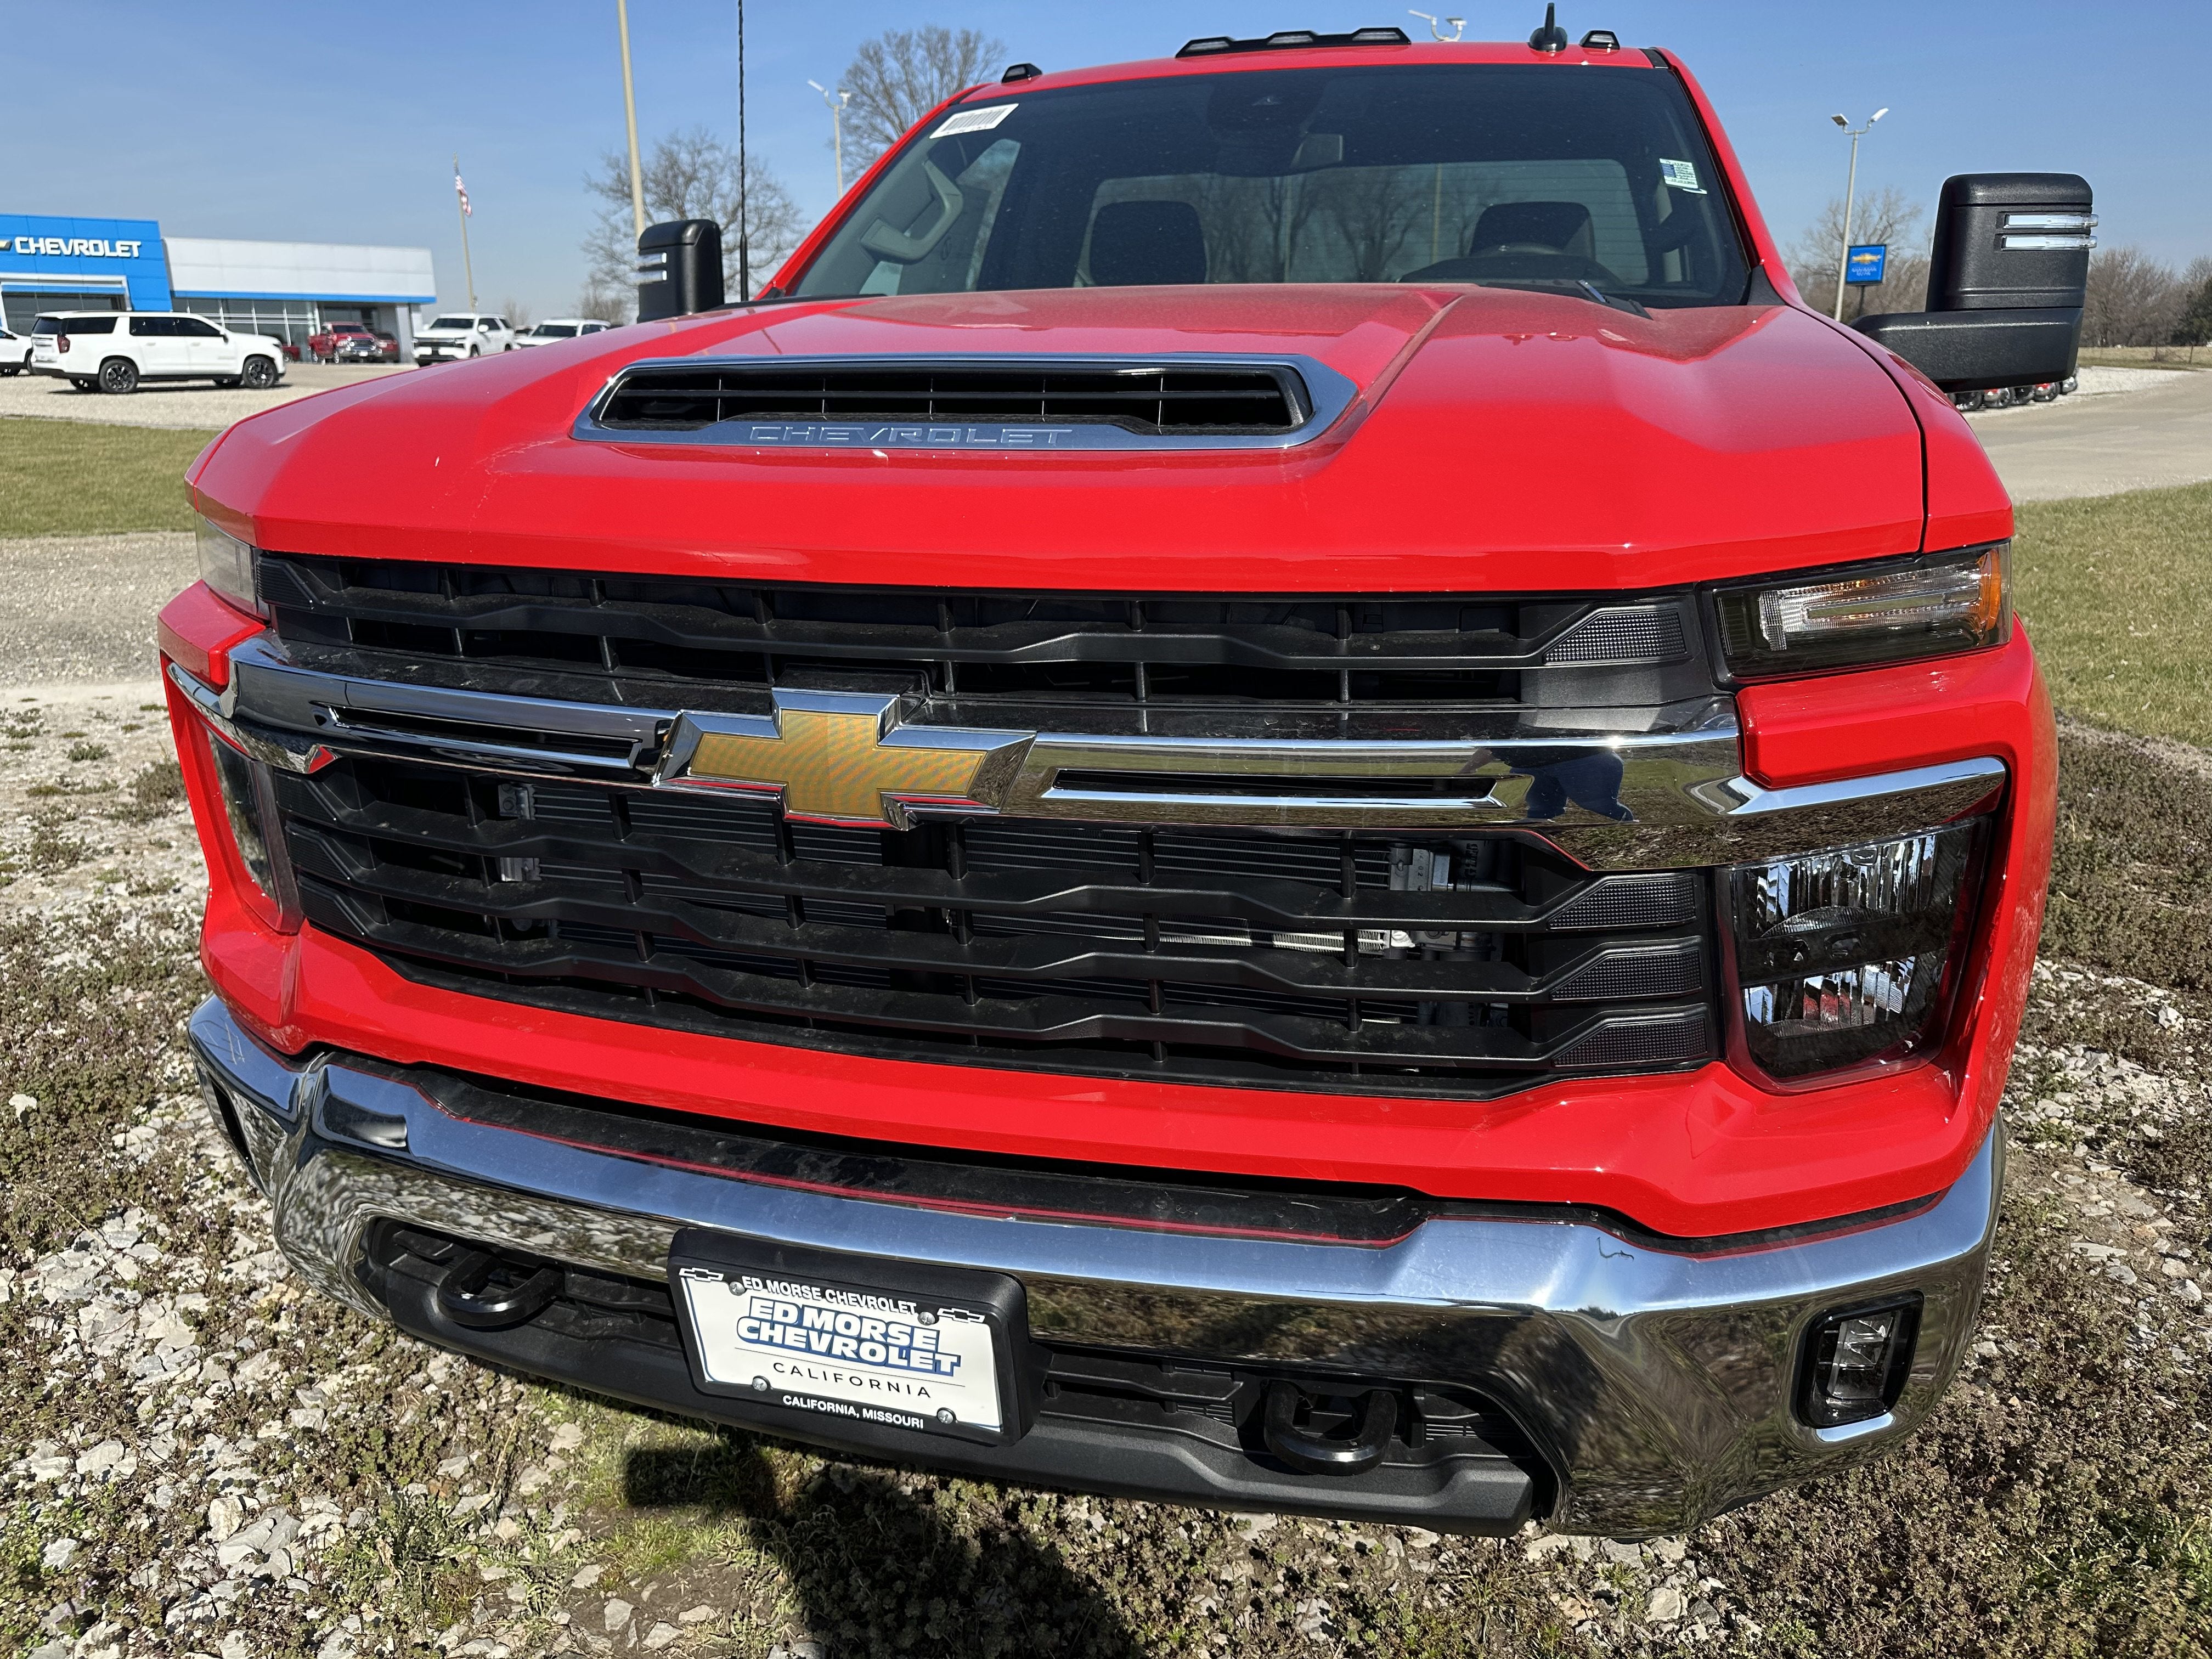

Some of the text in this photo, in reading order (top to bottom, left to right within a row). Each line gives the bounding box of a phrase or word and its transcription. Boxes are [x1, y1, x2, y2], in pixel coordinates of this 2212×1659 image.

[15, 236, 142, 258] CHEVROLET
[750, 426, 1073, 444] CHEVROLET
[742, 1276, 917, 1314] ED MORSE CHEVROLET
[749, 1296, 940, 1352] ED MORSE
[737, 1316, 961, 1376] CHEVROLET
[773, 1362, 932, 1398] CALIFORNIA
[783, 1395, 924, 1429] CALIFORNIA, MISSOURI
